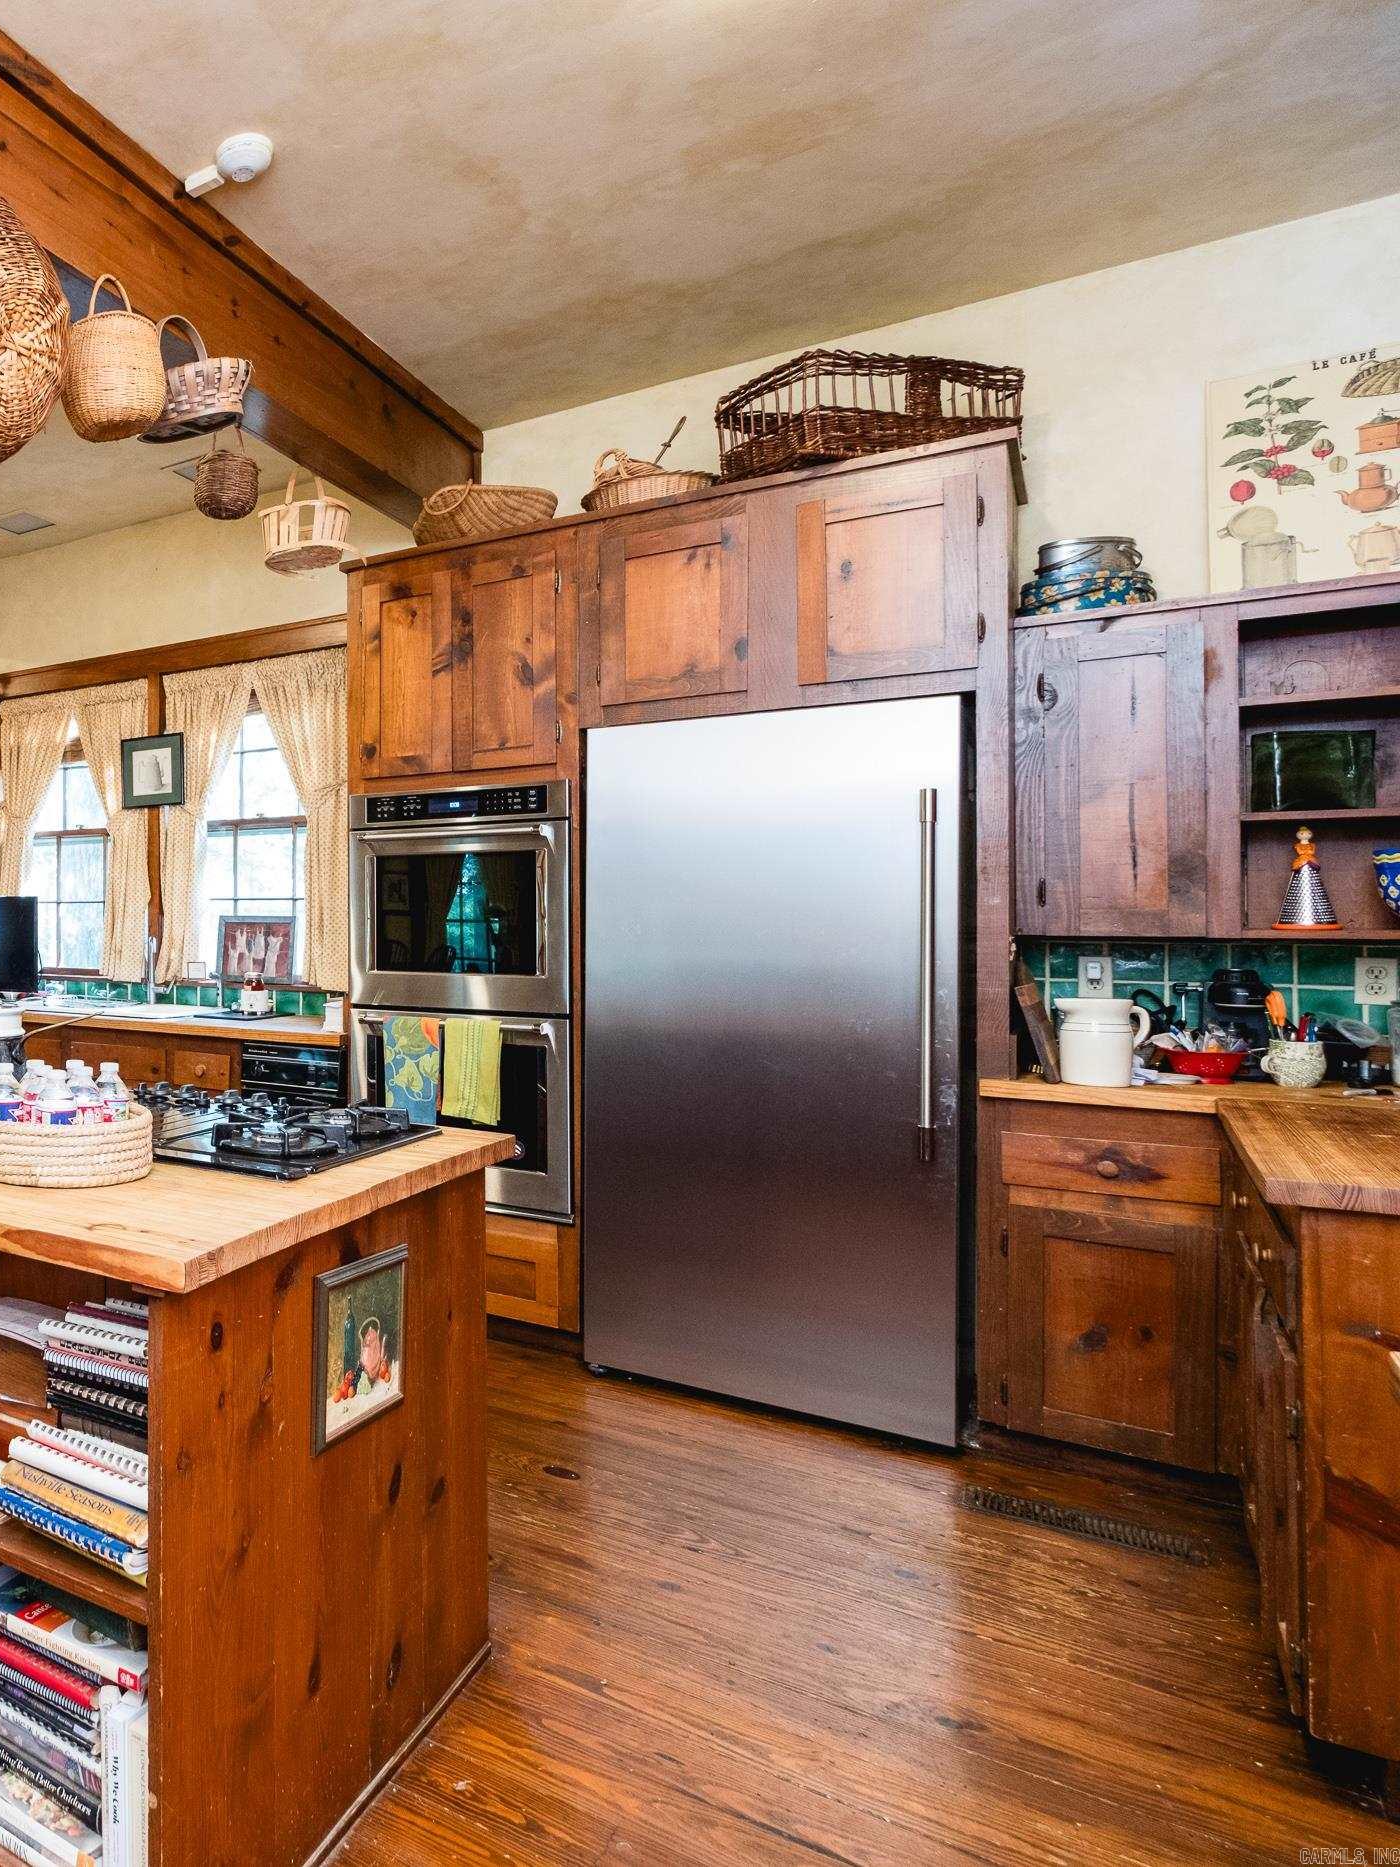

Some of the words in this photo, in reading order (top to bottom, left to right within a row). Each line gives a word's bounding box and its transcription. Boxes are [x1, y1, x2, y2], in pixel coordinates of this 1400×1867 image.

[1312, 360, 1329, 371] LE
[1340, 348, 1378, 365] CAFÉ
[16, 1463, 66, 1497] Nashville
[65, 1485, 113, 1516] Seasons
[24, 1602, 52, 1620] Cance
[110, 1756, 119, 1775] Why
[35, 1770, 57, 1794] Better
[55, 1784, 93, 1817] Outdoors
